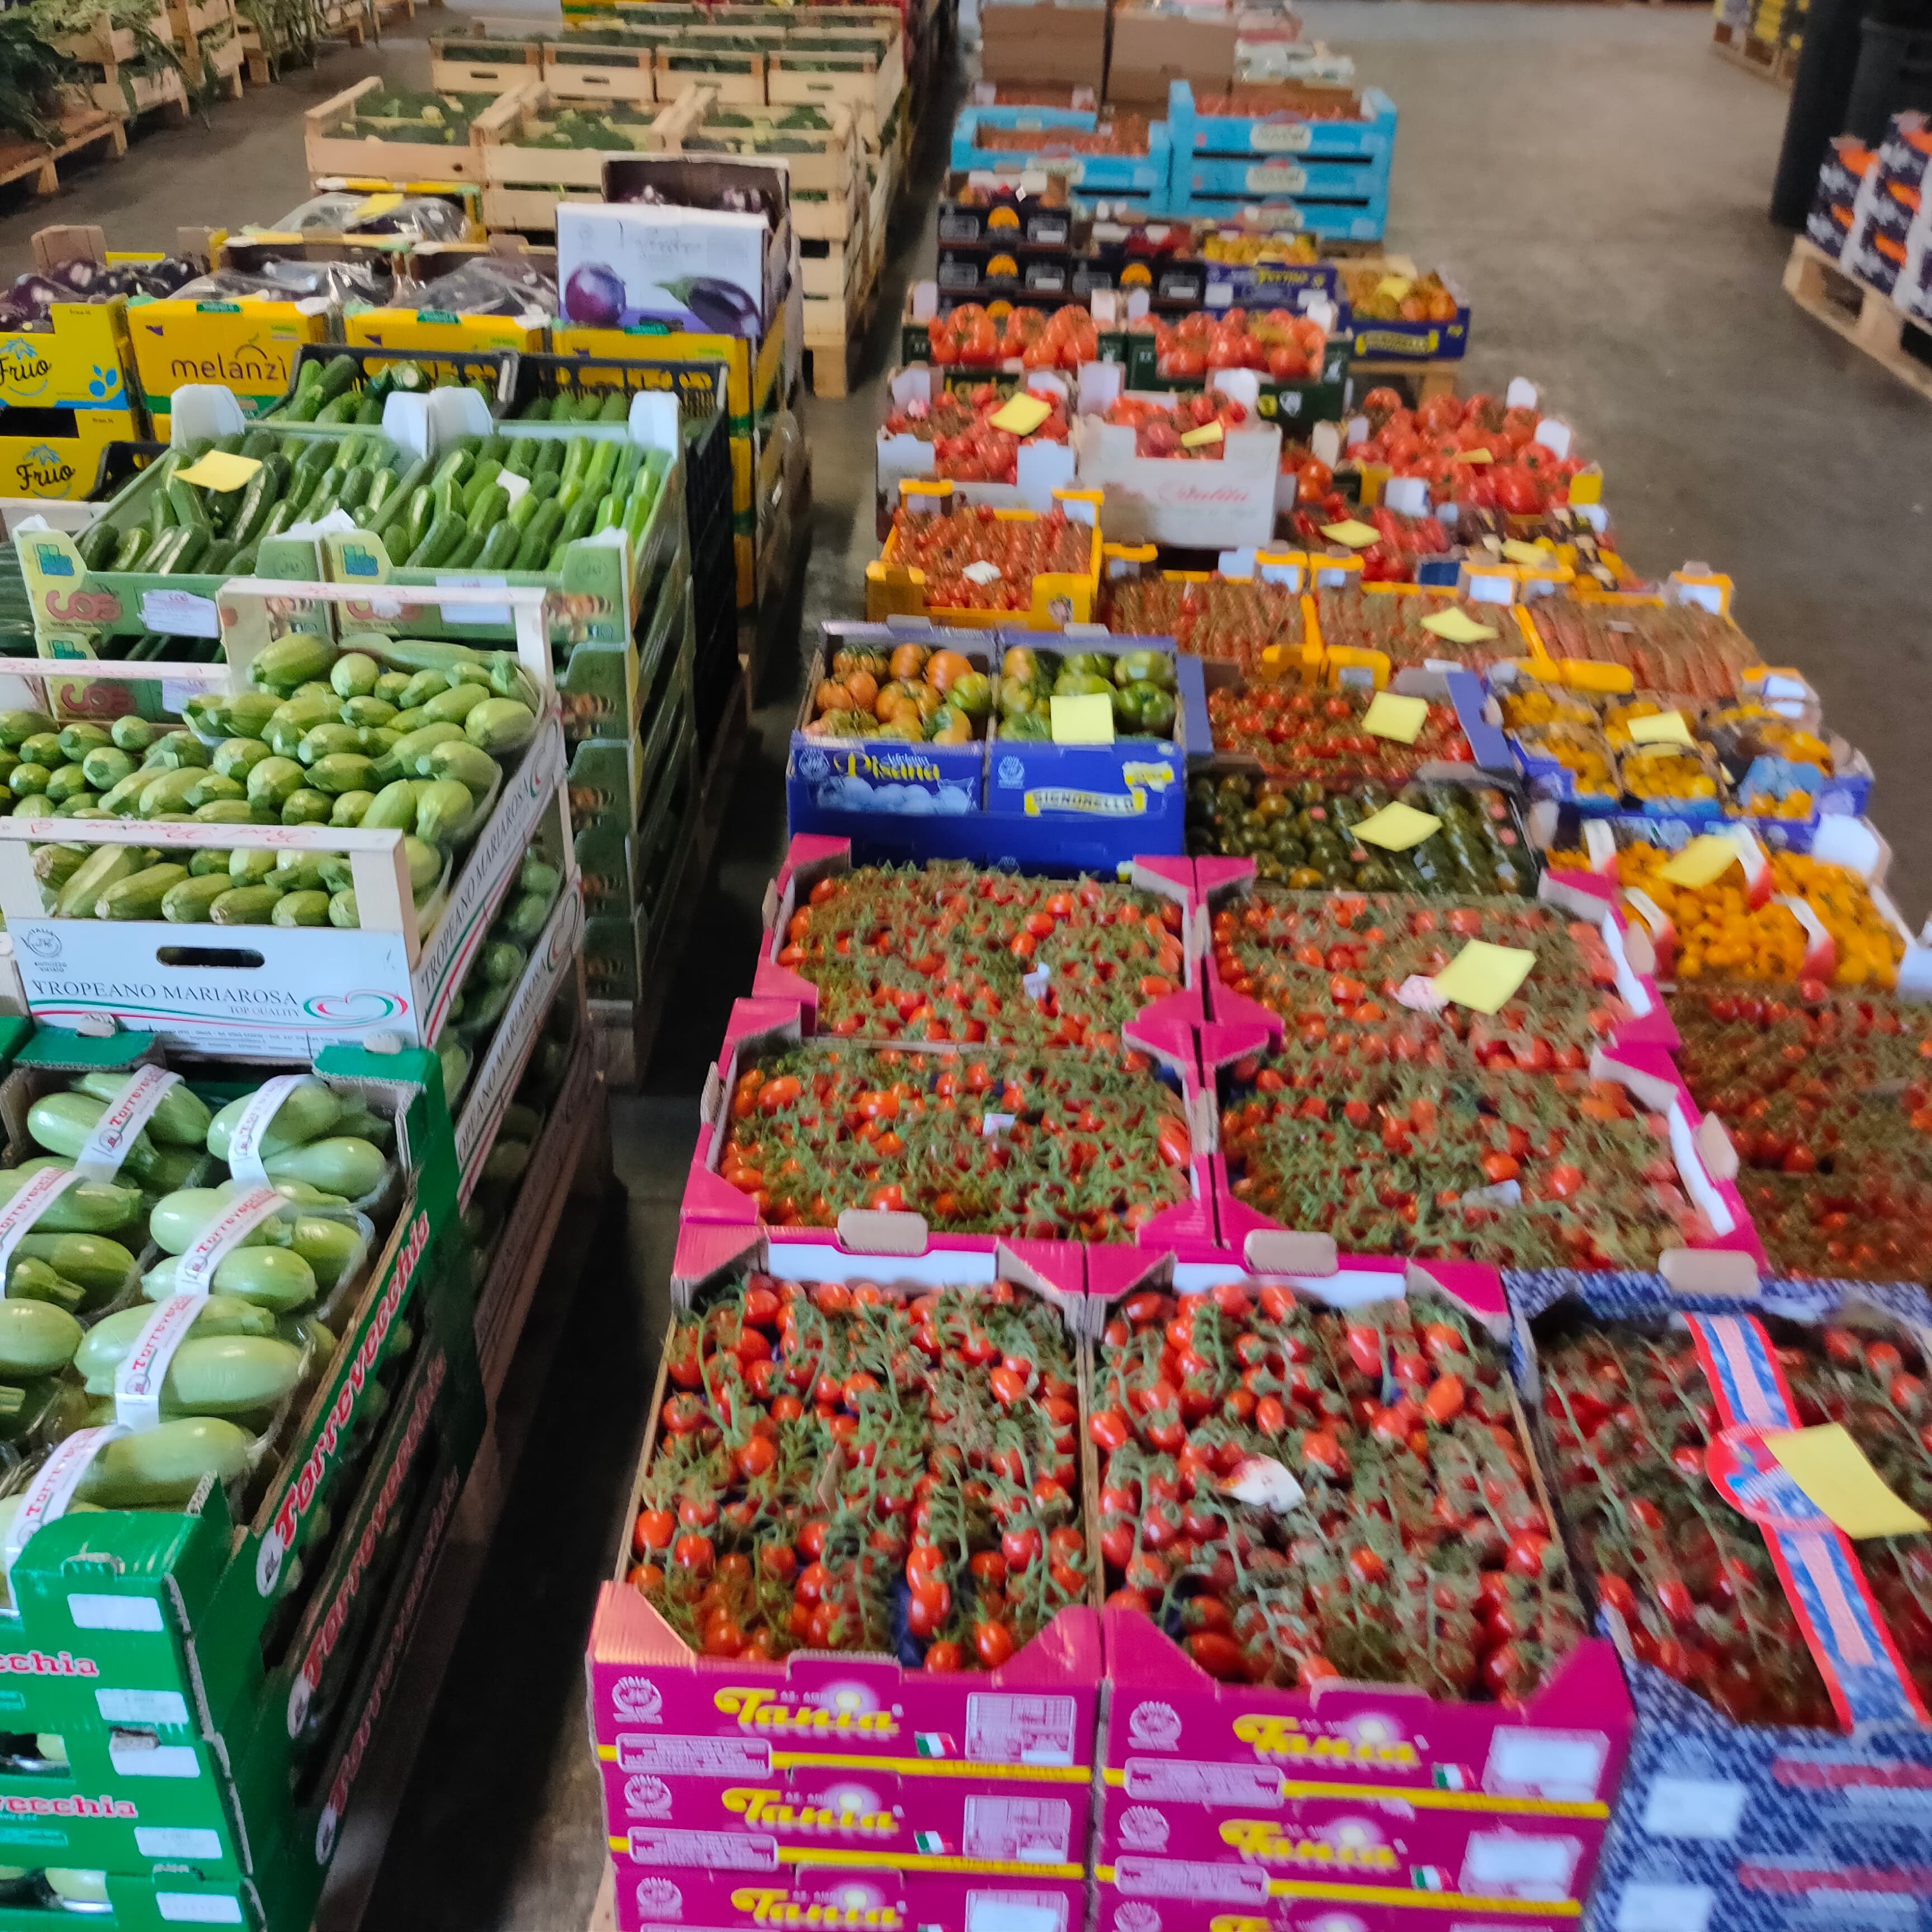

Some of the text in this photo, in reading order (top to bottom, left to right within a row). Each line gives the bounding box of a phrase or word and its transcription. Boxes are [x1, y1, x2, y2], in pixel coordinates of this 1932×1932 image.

[420, 875, 476, 993] TROPEANO
[32, 979, 298, 1006] TROPEANO MARIAROSA
[457, 1069, 496, 1165] OPEANO
[275, 1209, 430, 1551] Torrevecchia
[714, 1686, 901, 1735] Tania
[0, 1794, 138, 1819] ecchia
